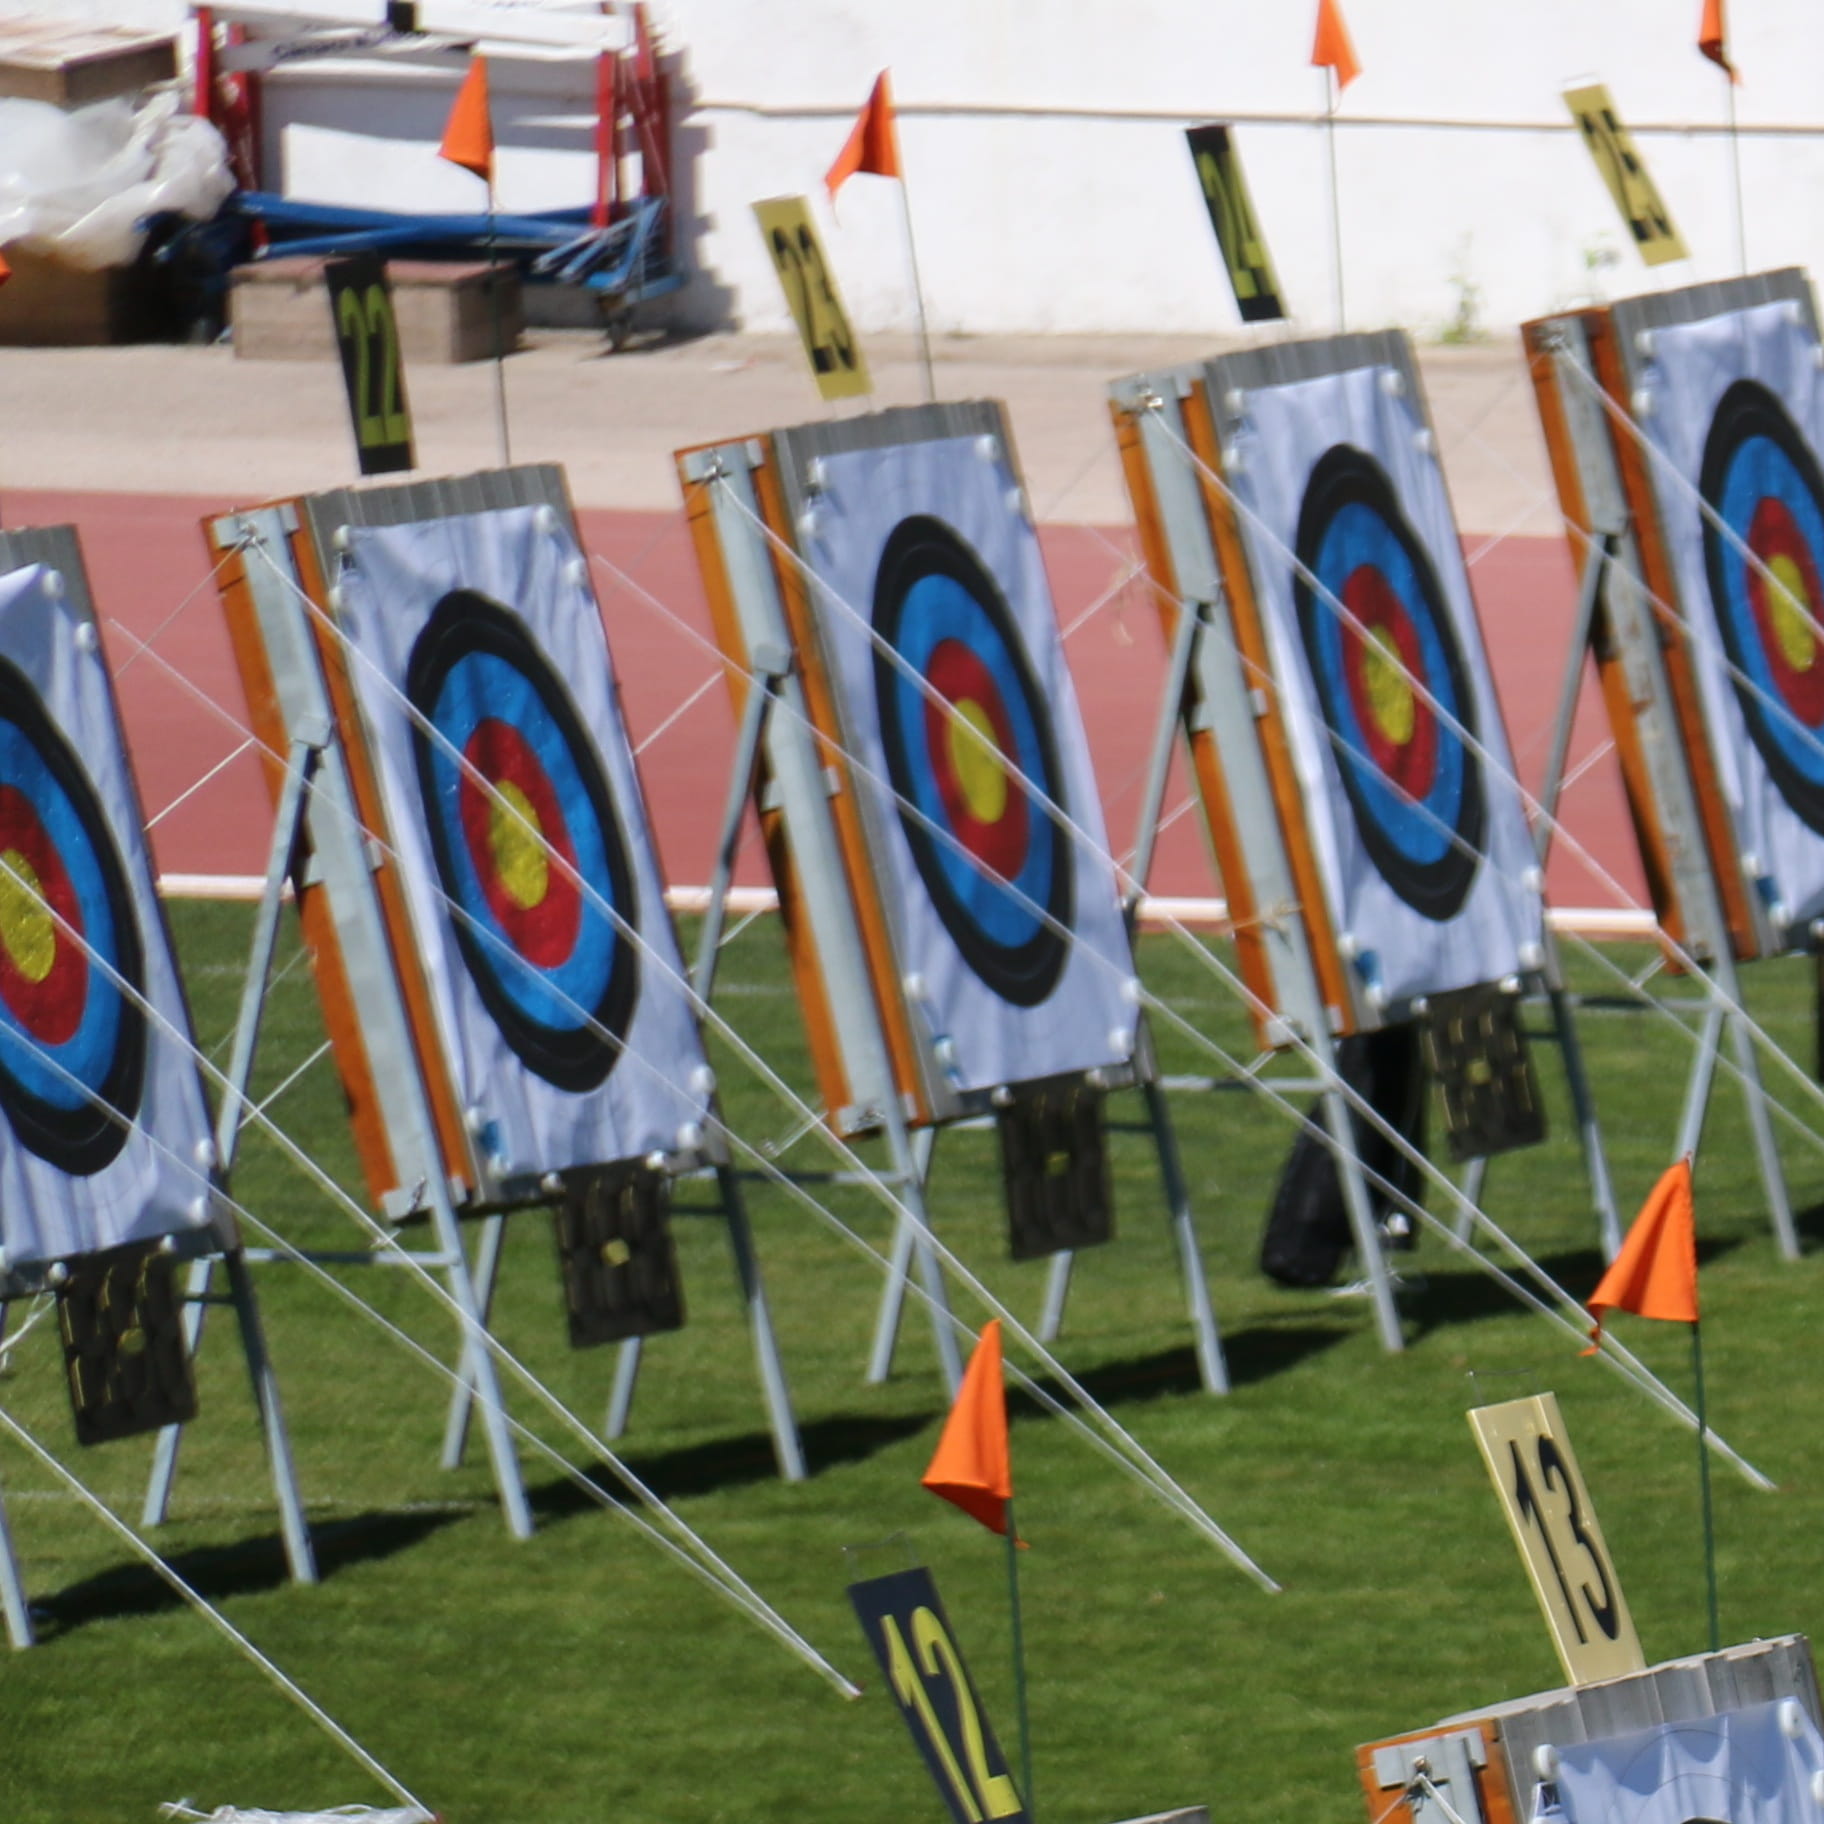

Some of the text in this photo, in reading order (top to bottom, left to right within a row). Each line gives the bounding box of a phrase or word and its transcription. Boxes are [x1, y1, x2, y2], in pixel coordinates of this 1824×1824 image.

[1197, 151, 1282, 298] 24
[1580, 109, 1674, 241] 25
[339, 285, 407, 448] 22
[771, 224, 857, 374] 23
[1506, 1433, 1620, 1644] 13
[879, 1604, 1022, 1824] 12
